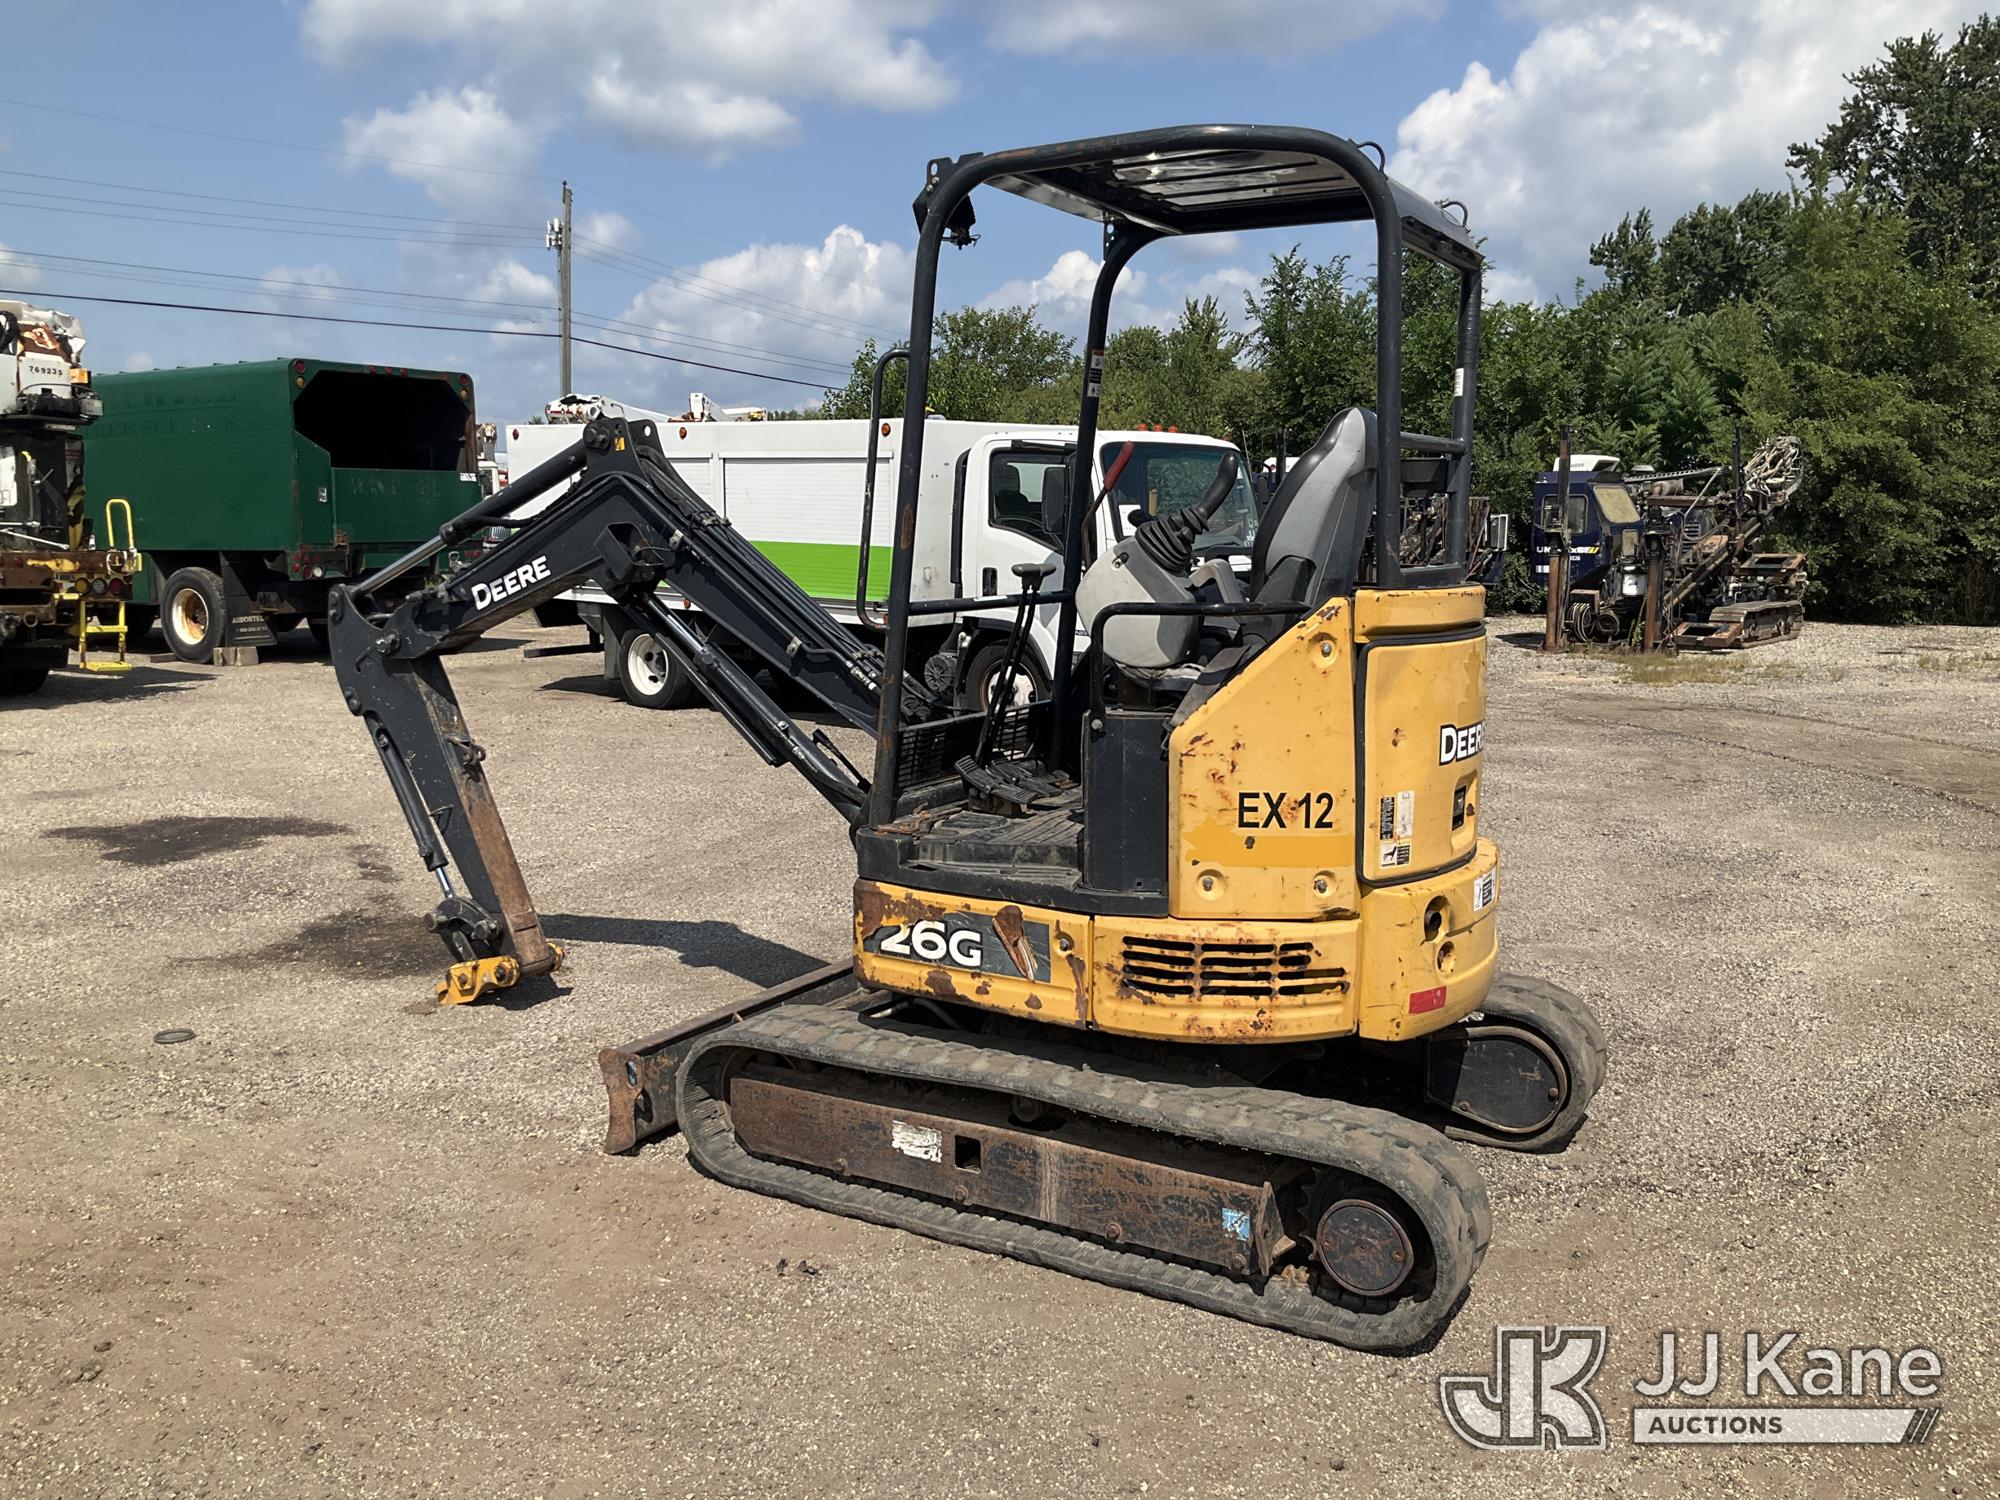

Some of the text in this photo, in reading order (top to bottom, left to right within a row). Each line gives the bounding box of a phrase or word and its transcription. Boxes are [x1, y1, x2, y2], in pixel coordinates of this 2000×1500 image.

[471, 555, 551, 611] DEERE
[1440, 722, 1484, 764] DEER
[1238, 792, 1333, 828] EX 12
[880, 919, 981, 967] 26G
